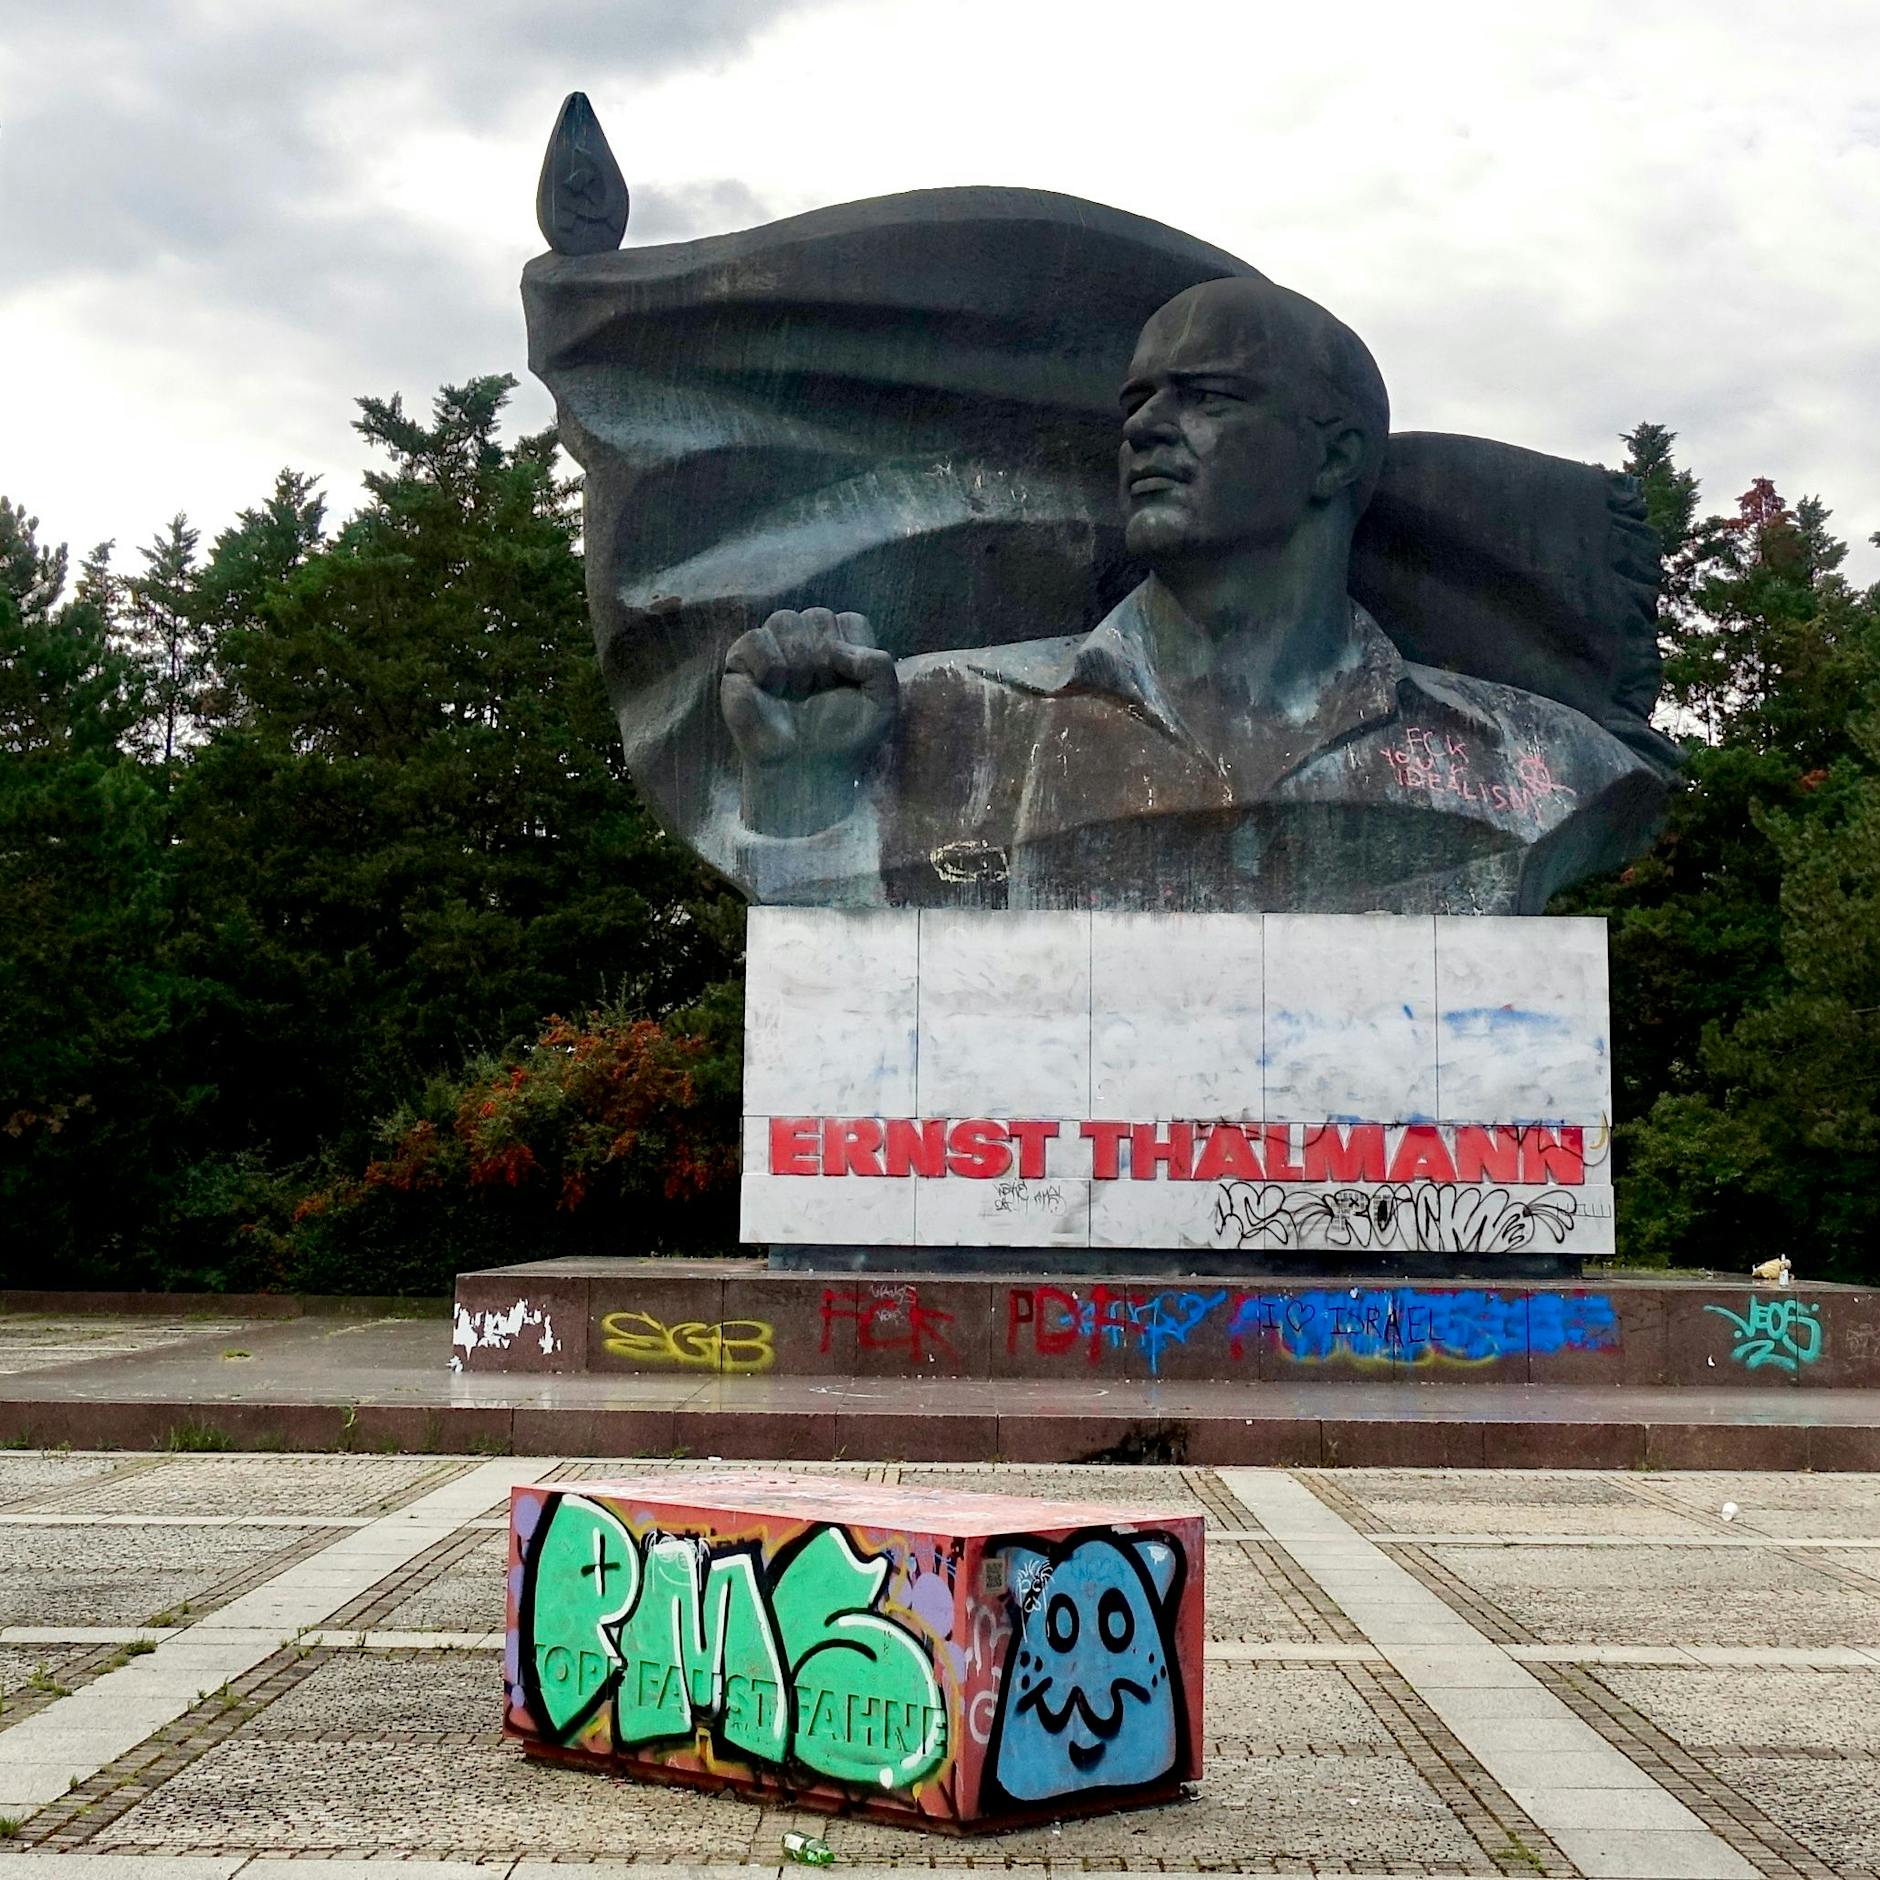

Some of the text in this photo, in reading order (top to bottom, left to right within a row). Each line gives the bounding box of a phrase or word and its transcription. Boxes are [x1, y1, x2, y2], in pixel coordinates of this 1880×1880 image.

[1406, 727, 1469, 764] FCK
[769, 1116, 1060, 1179] ERNST
[819, 1289, 957, 1364] FCK
[1330, 1305, 1446, 1347] ISRAEL
[638, 1659, 780, 1729] FAUST
[793, 1684, 949, 1760] FAHNE
